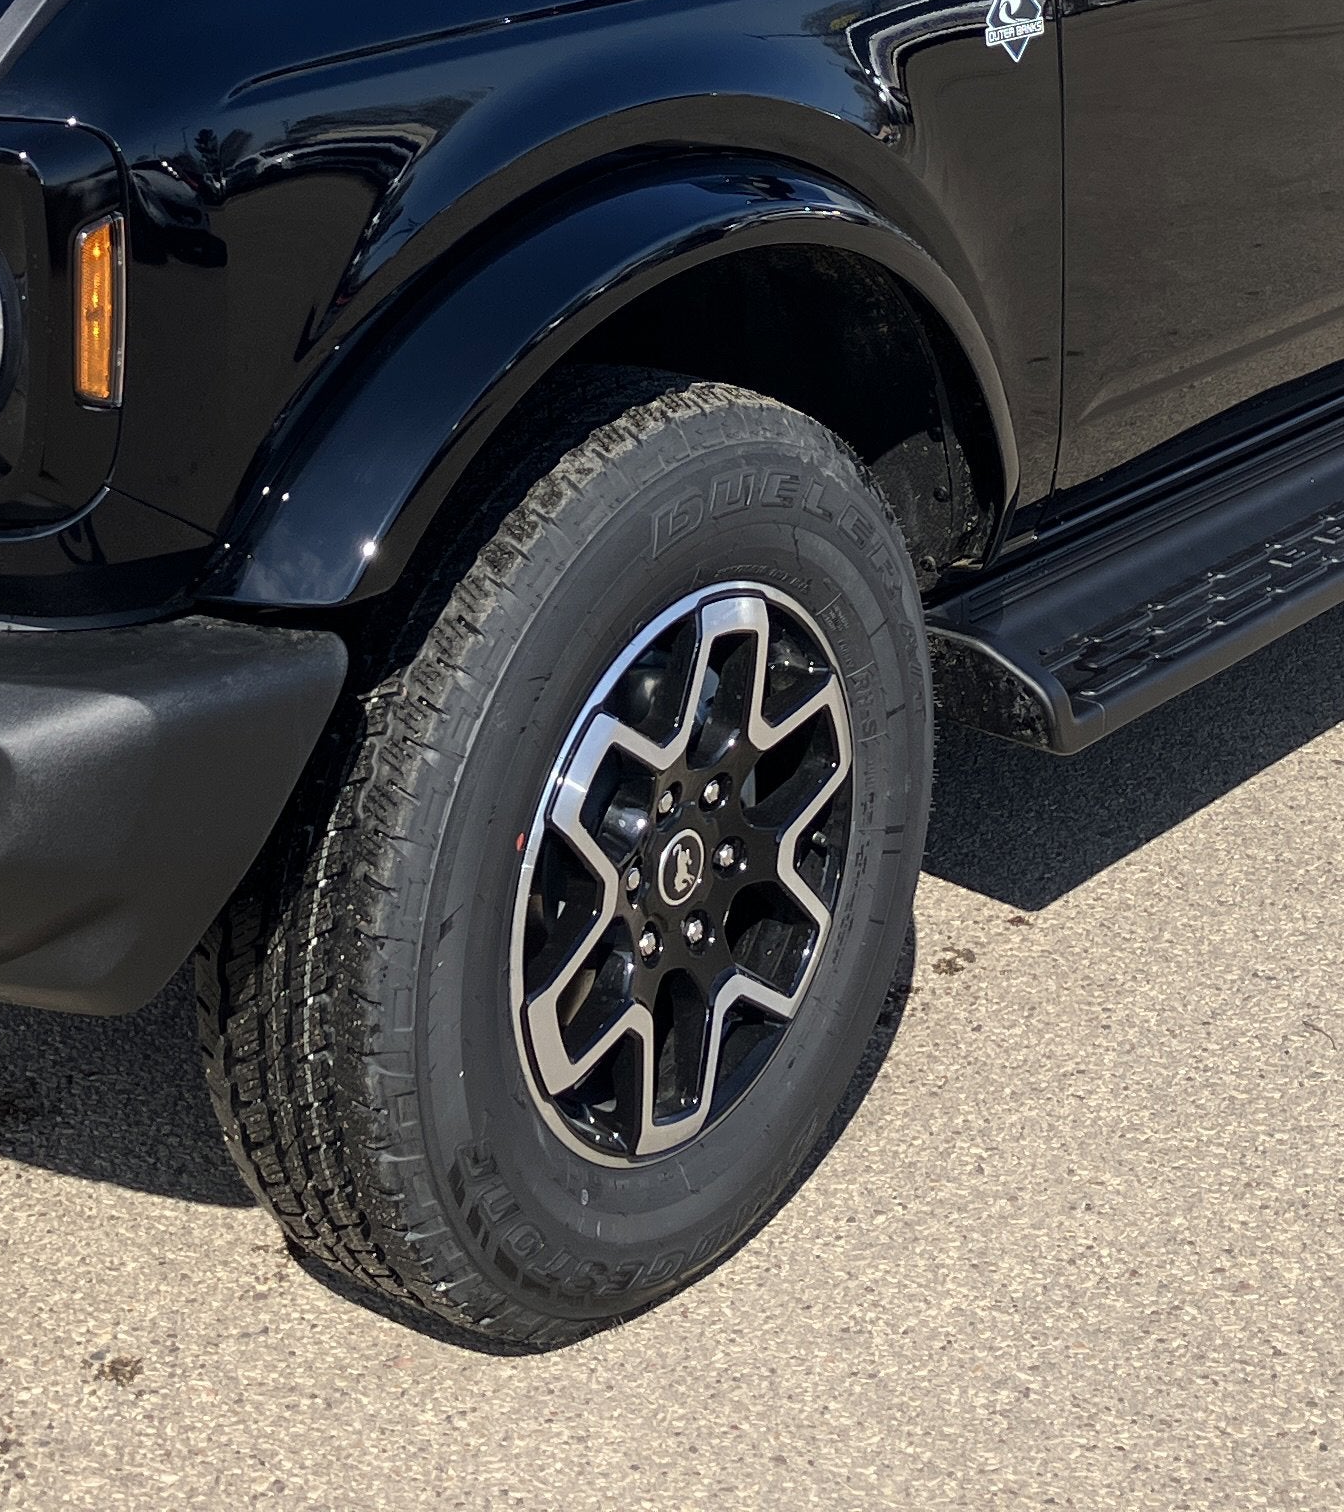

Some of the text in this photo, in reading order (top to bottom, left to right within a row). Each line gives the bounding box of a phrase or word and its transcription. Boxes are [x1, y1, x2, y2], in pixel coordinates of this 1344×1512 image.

[988, 20, 1043, 43] OUTER BANKS
[650, 471, 906, 600] DUELER
